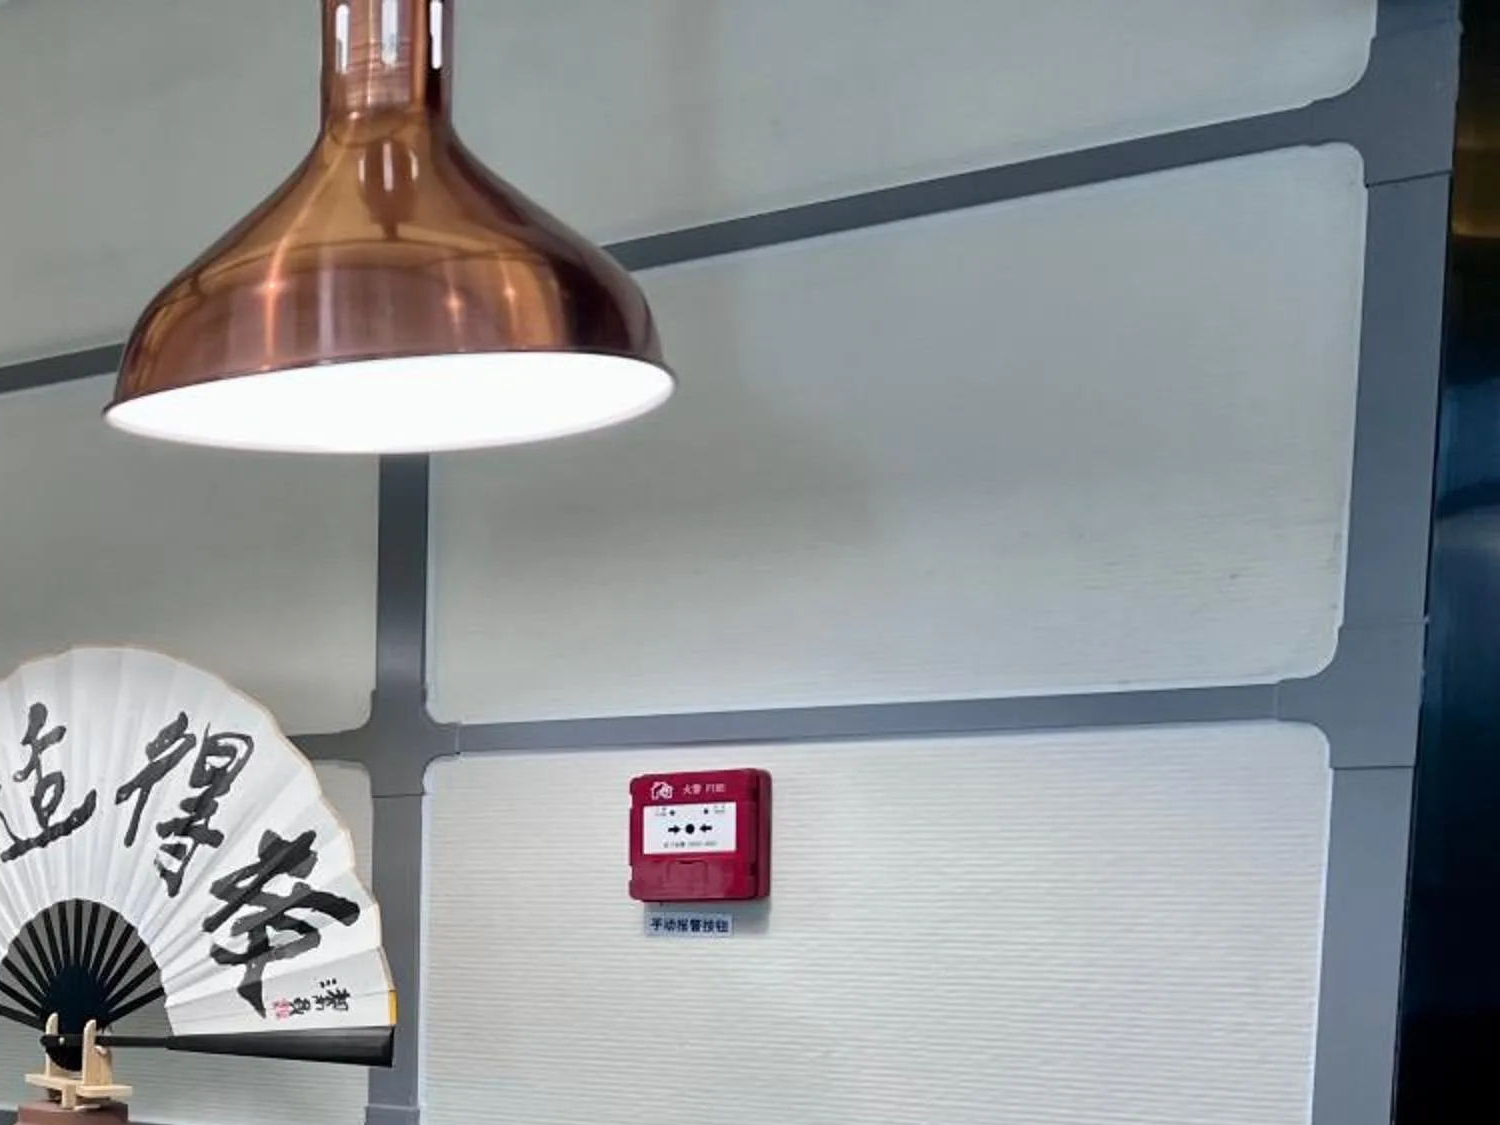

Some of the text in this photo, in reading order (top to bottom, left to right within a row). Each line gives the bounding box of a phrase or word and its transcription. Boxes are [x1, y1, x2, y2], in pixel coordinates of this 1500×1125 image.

[651, 917, 730, 933] 手动报警按钮
